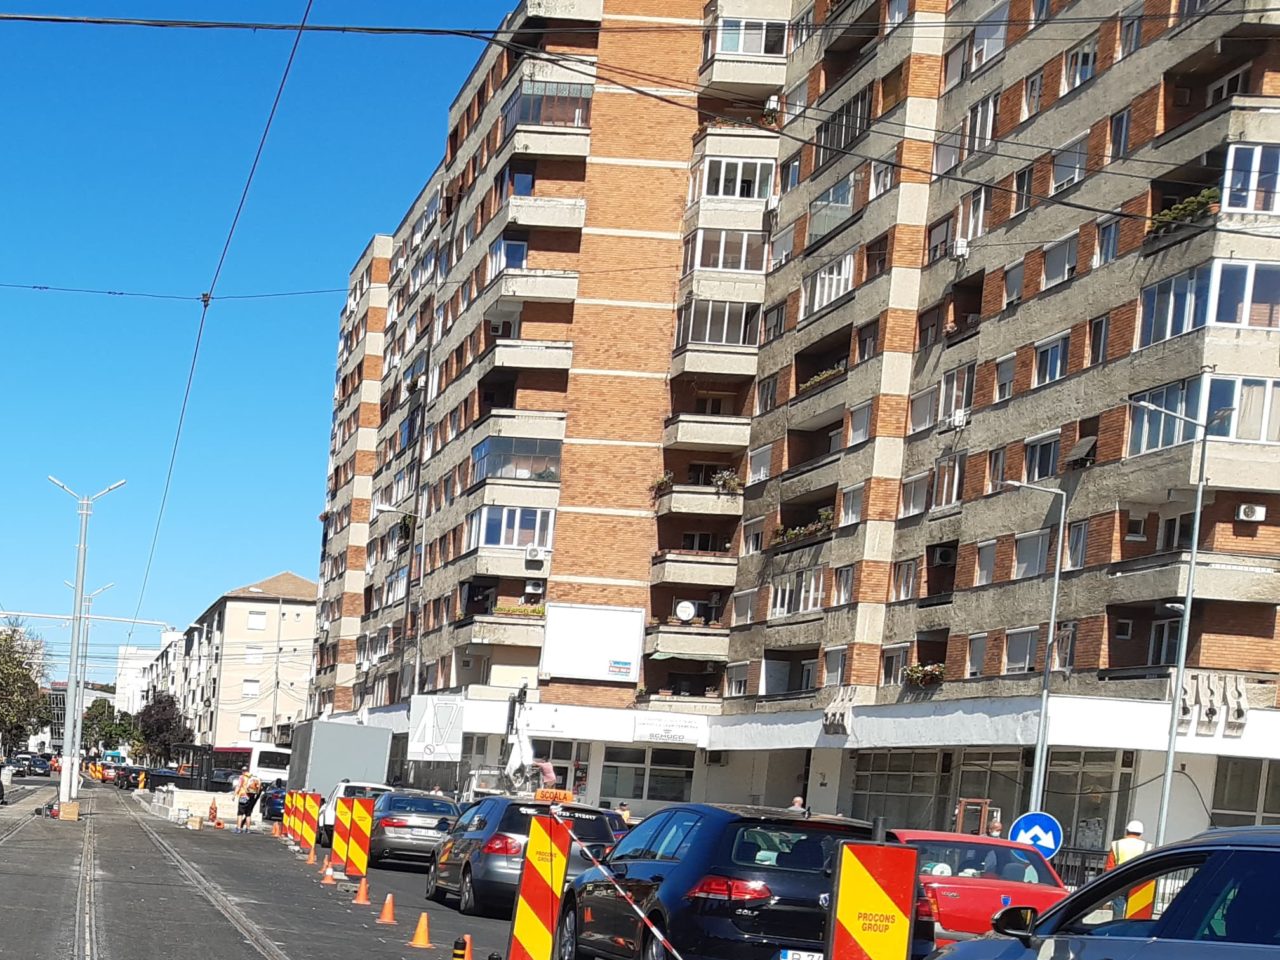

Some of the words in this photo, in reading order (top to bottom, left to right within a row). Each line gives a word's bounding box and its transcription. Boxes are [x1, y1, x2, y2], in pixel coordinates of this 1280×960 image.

[735, 908, 759, 916] GOLF
[857, 912, 896, 924] PROCONS
[861, 922, 890, 933] GROUP
